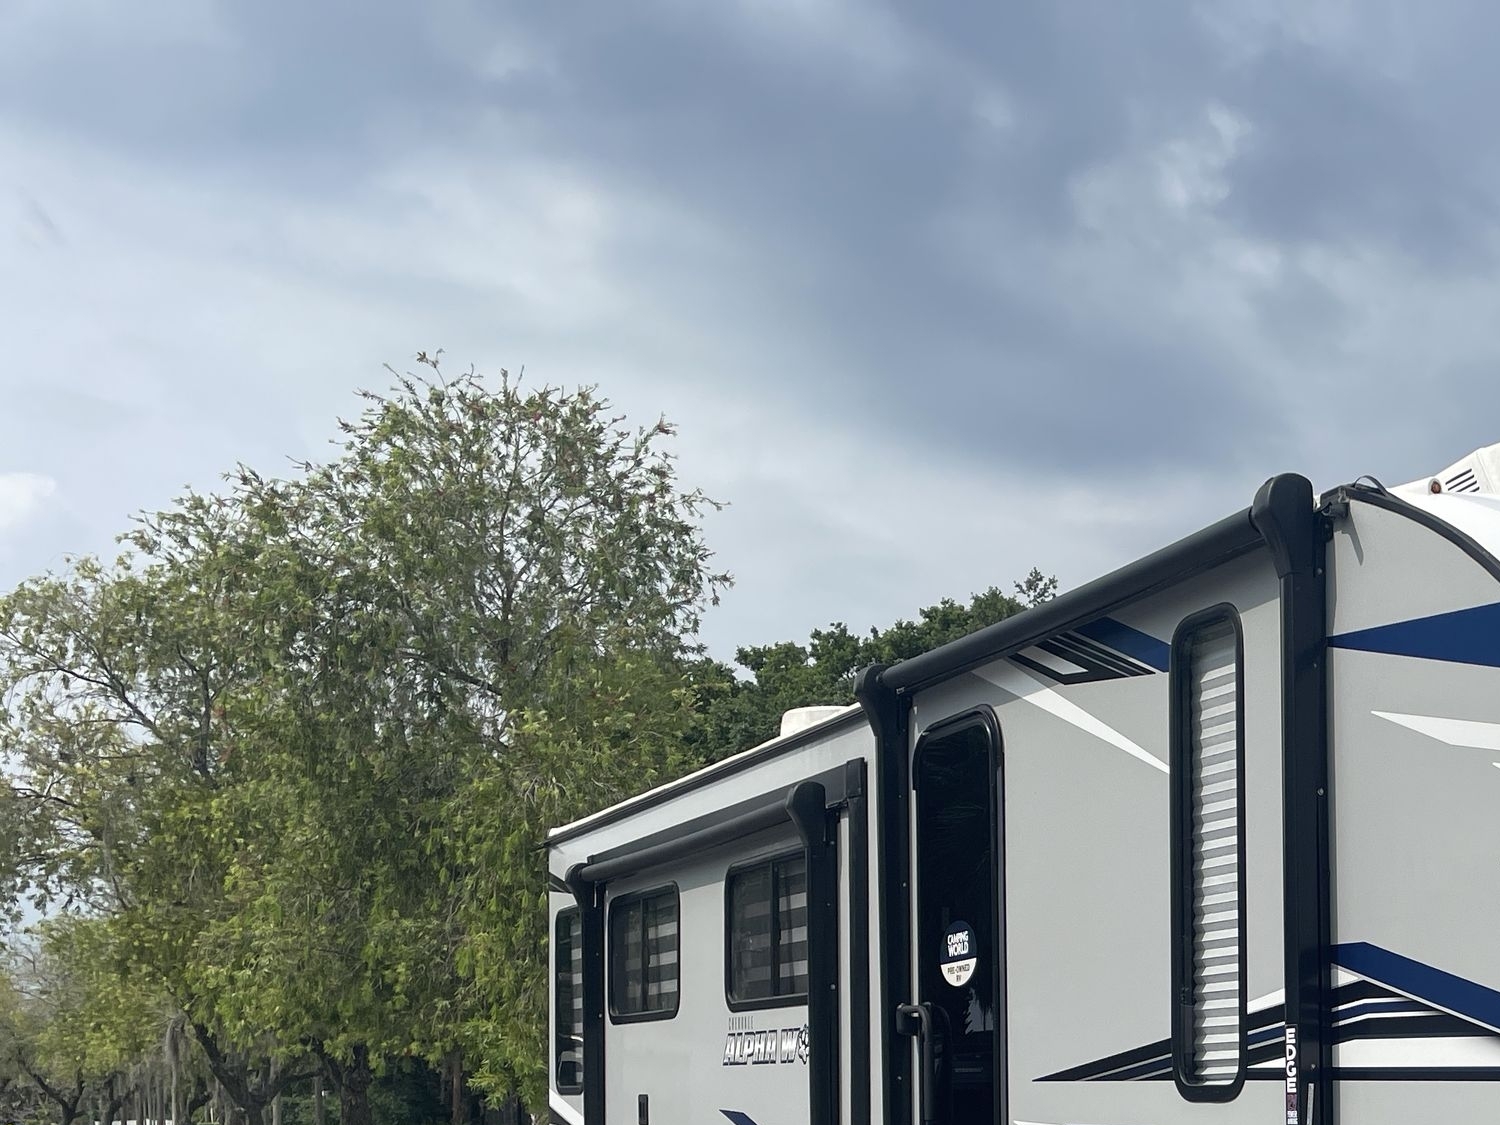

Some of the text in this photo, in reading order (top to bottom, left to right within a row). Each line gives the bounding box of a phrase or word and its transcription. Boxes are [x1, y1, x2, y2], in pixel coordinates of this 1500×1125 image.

[947, 930, 969, 945] CAMPING
[947, 941, 969, 957] WORLD
[723, 1029, 778, 1066] ALPHA
[1285, 1027, 1297, 1093] EDGE
